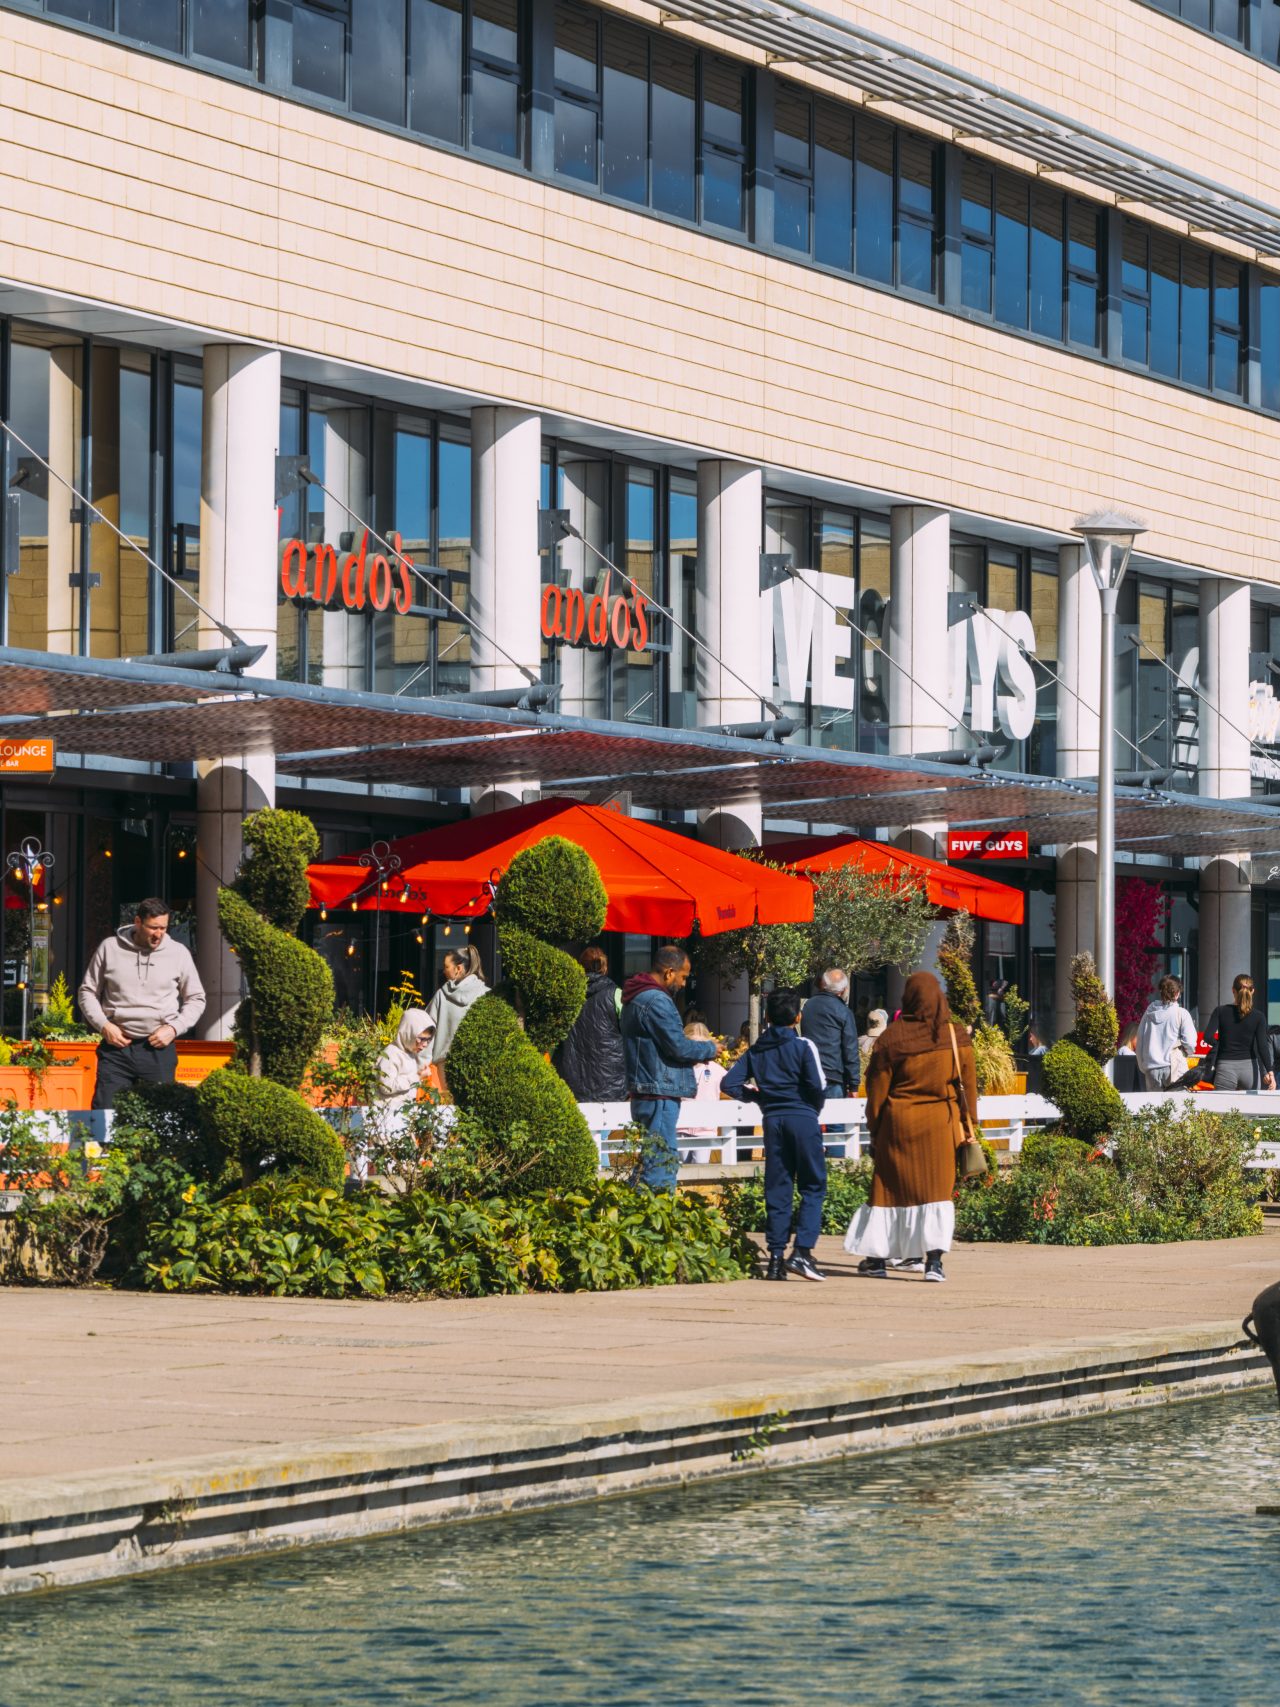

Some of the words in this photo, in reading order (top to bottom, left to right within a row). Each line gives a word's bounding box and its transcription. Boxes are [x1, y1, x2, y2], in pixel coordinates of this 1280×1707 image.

[279, 525, 414, 615] ando's
[541, 570, 648, 652] ando's
[760, 567, 855, 710] IVE
[951, 840, 982, 851] FIVE
[985, 840, 1023, 851] GUYS
